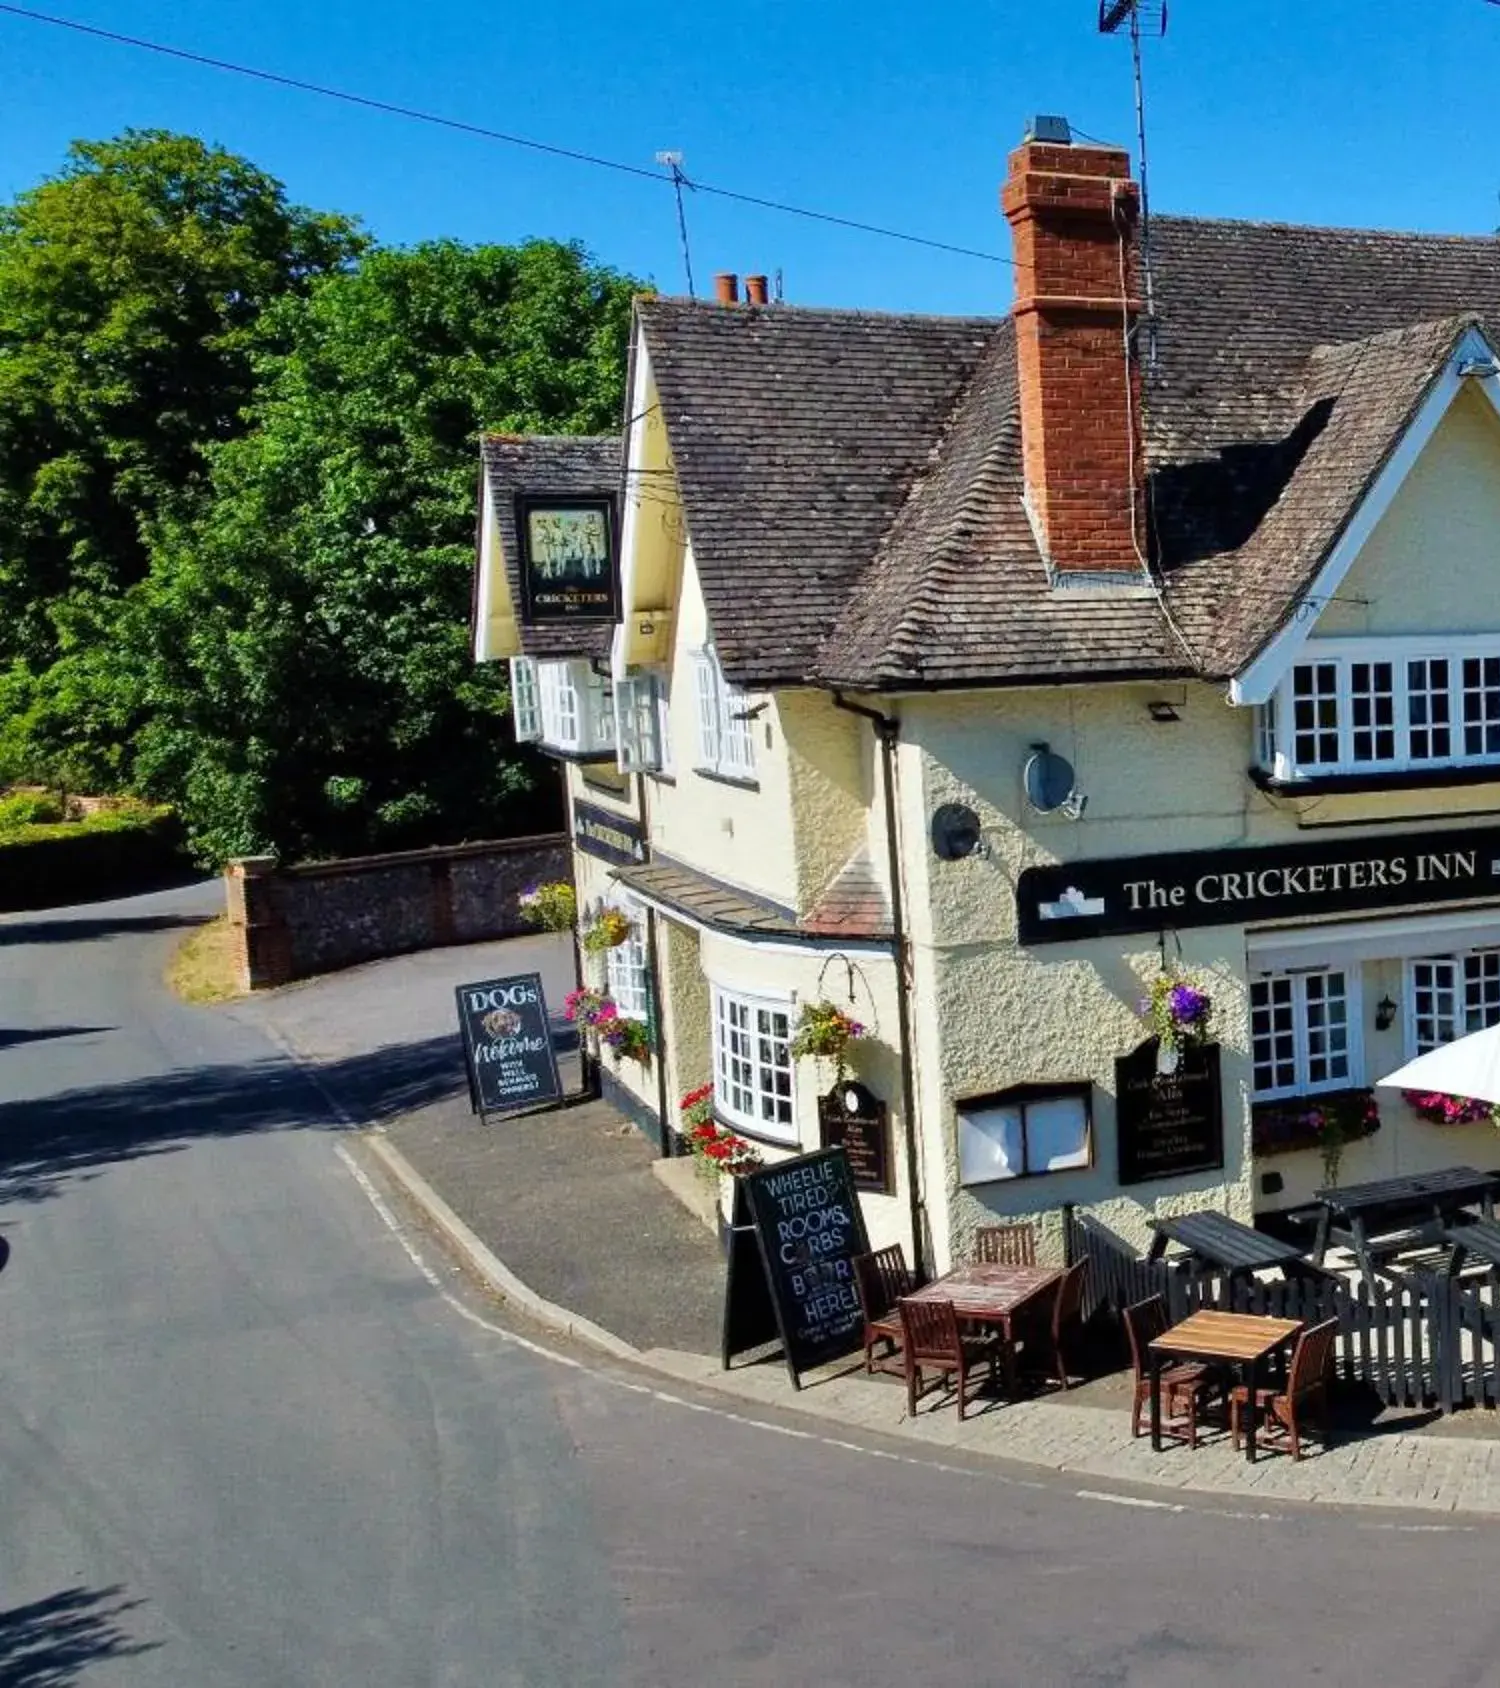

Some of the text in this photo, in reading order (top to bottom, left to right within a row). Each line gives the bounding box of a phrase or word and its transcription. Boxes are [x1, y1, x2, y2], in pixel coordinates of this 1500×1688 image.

[1123, 850, 1477, 910] The CRICKETERS INN
